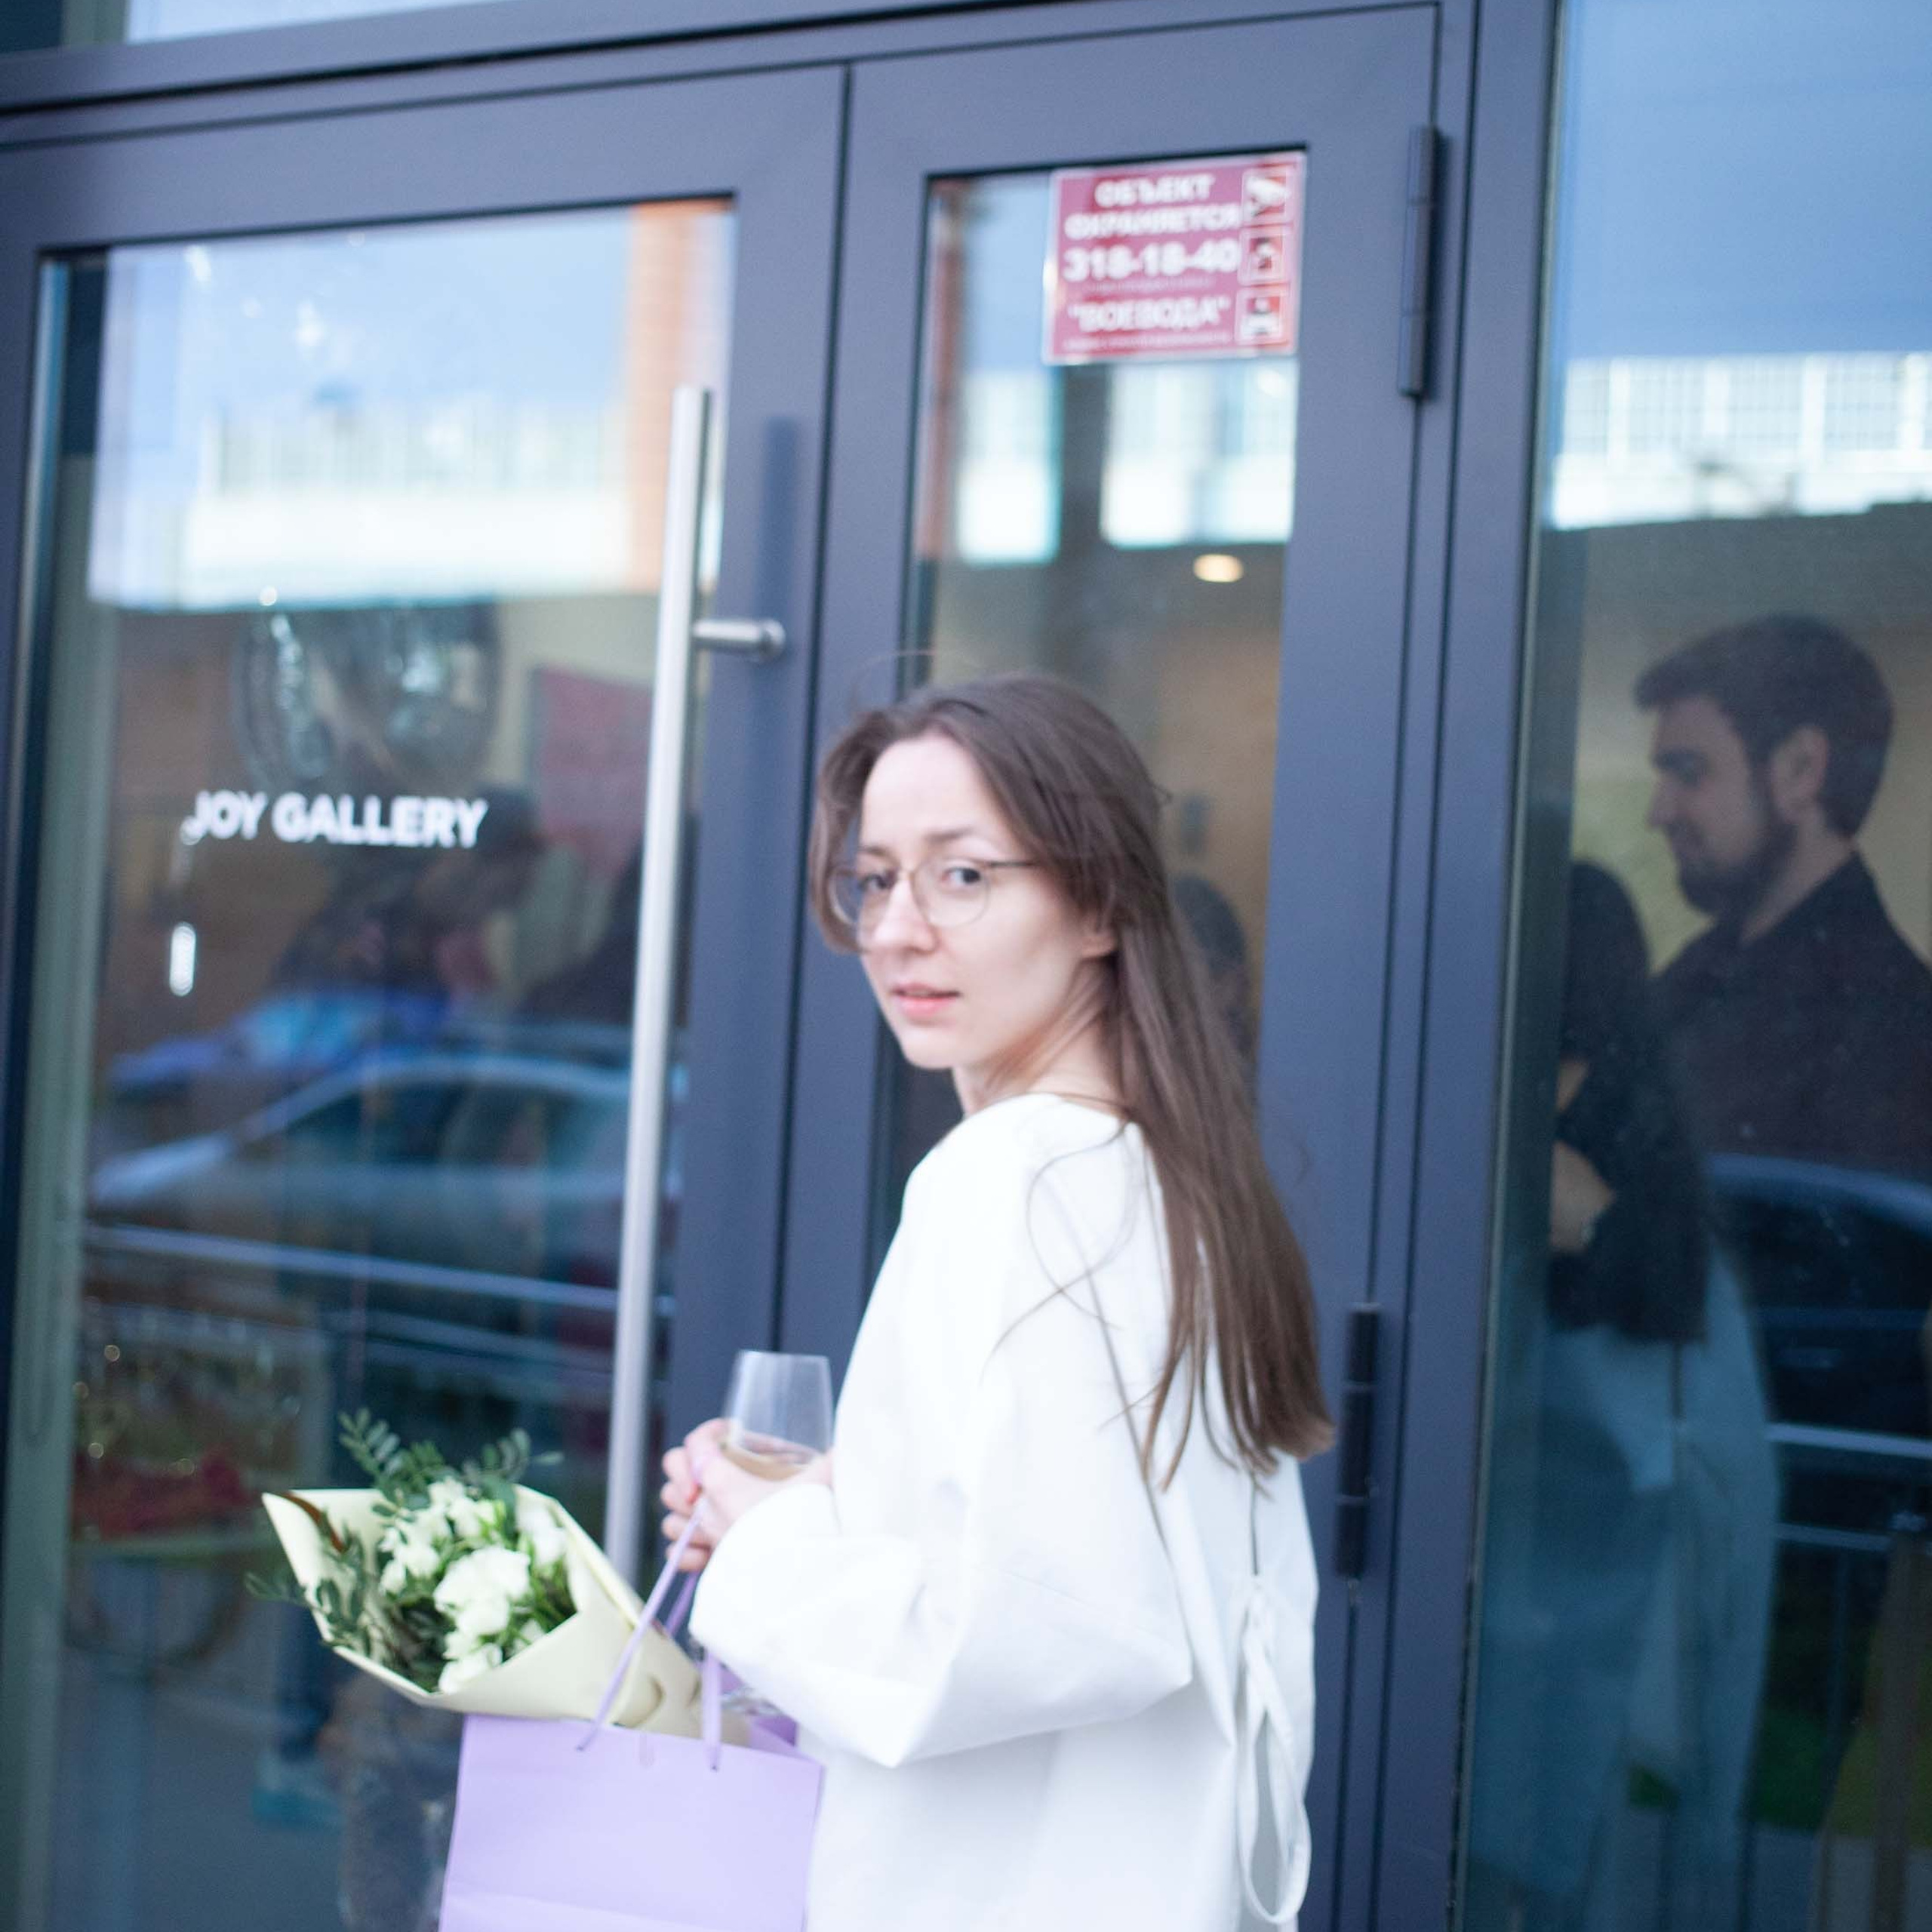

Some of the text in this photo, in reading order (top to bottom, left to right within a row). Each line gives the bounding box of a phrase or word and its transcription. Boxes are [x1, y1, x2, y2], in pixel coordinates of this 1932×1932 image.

[1095, 174, 1214, 206] ОБЪЕКТ
[1065, 204, 1241, 239] ОХРАНЯЕТСЯ
[1063, 238, 1241, 281] 318-18-40
[181, 789, 488, 848] JOY GALLERY
